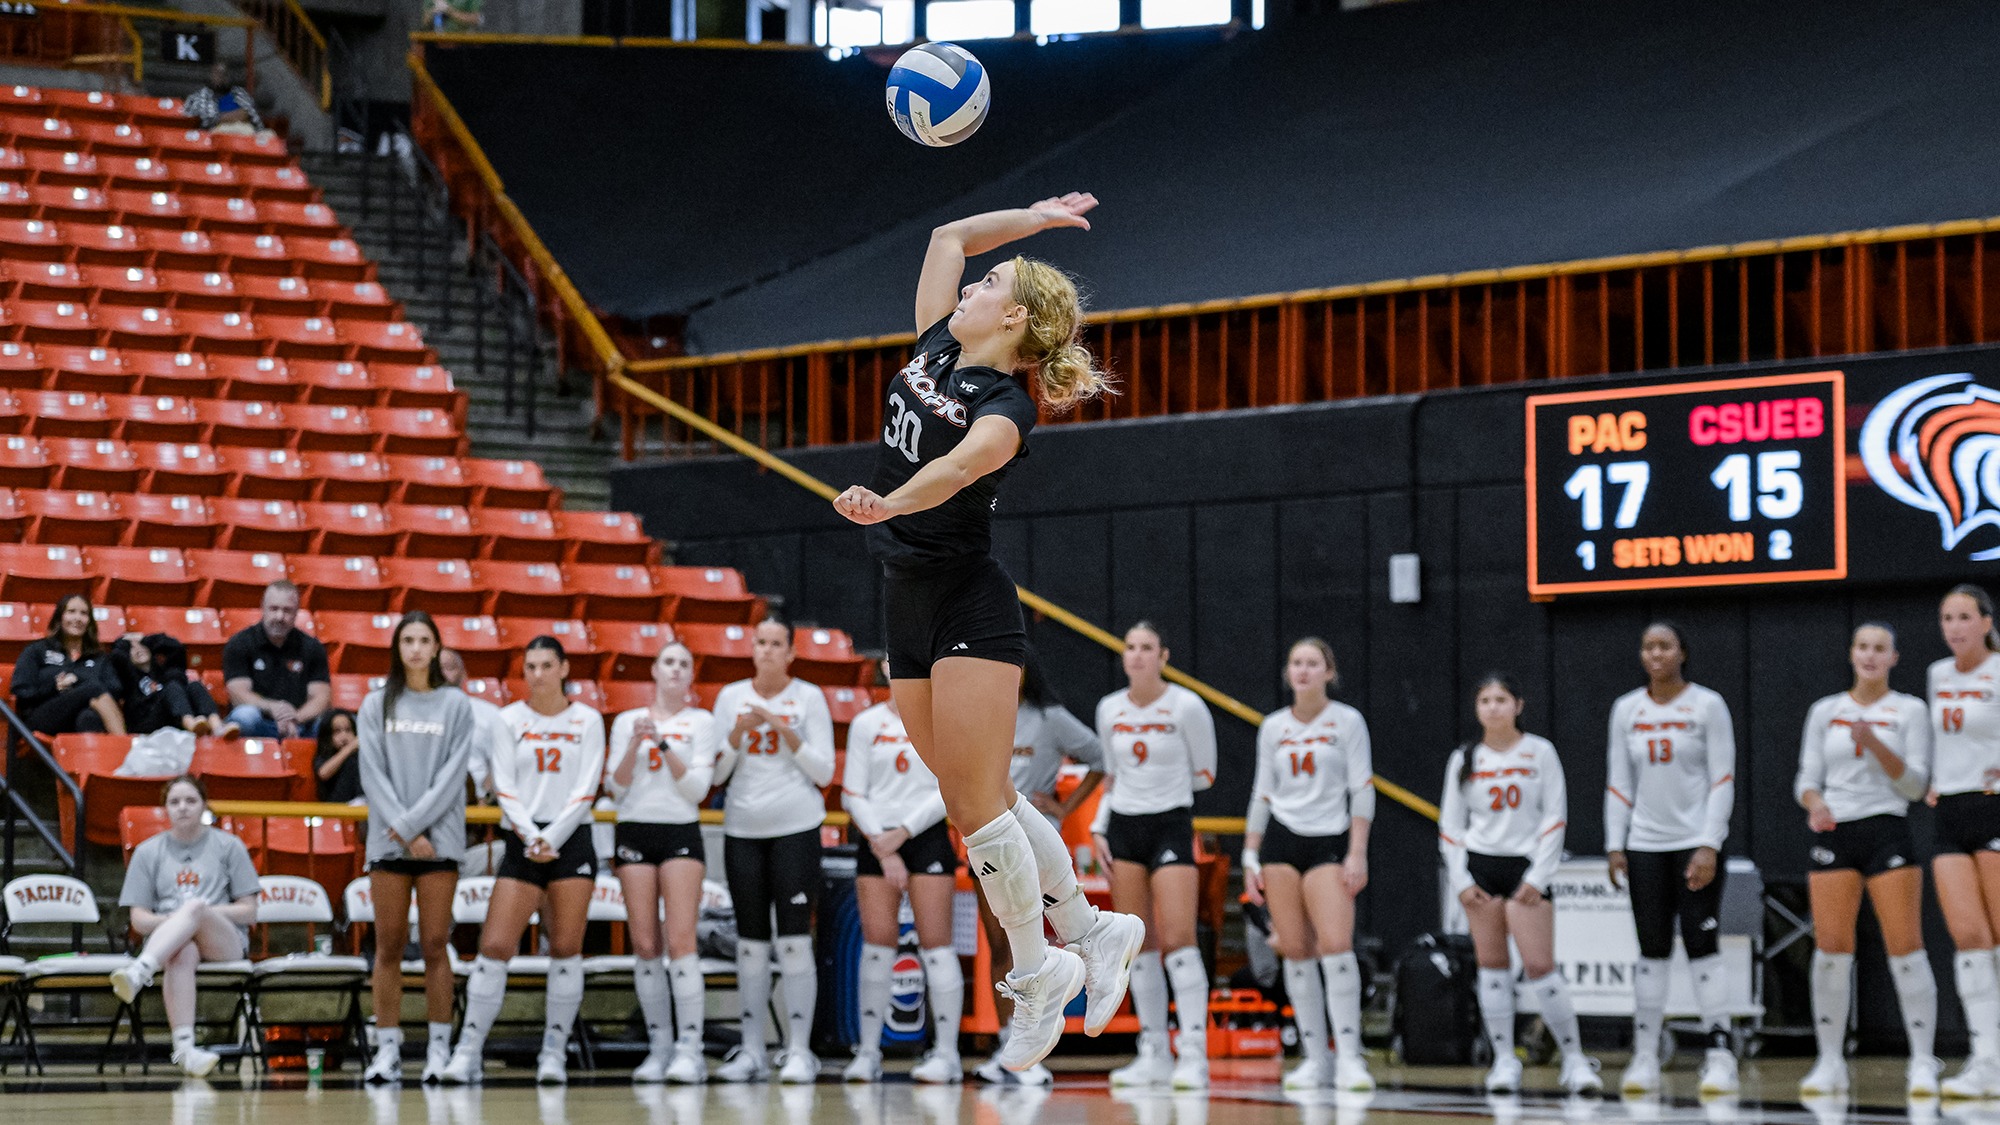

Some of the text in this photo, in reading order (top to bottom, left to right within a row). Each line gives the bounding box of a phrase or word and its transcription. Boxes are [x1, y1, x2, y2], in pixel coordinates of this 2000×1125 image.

[176, 34, 200, 61] K
[900, 351, 968, 428] PACIFIC
[884, 392, 922, 463] 30
[1568, 397, 1824, 455] PAC CSUEB
[1563, 449, 1804, 531] 17 15
[1576, 529, 1793, 571] 1 SETS WON 2
[1943, 707, 1965, 733] 19
[748, 729, 779, 755] 23
[1133, 741, 1148, 765] 9
[1648, 738, 1673, 765] 13
[535, 747, 562, 773] 12
[649, 748, 663, 771] 5
[895, 750, 910, 773] 6
[1289, 751, 1315, 777] 14
[1489, 784, 1521, 811] 20
[14, 885, 85, 907] PACIFIC
[260, 886, 318, 907] ACIFIC
